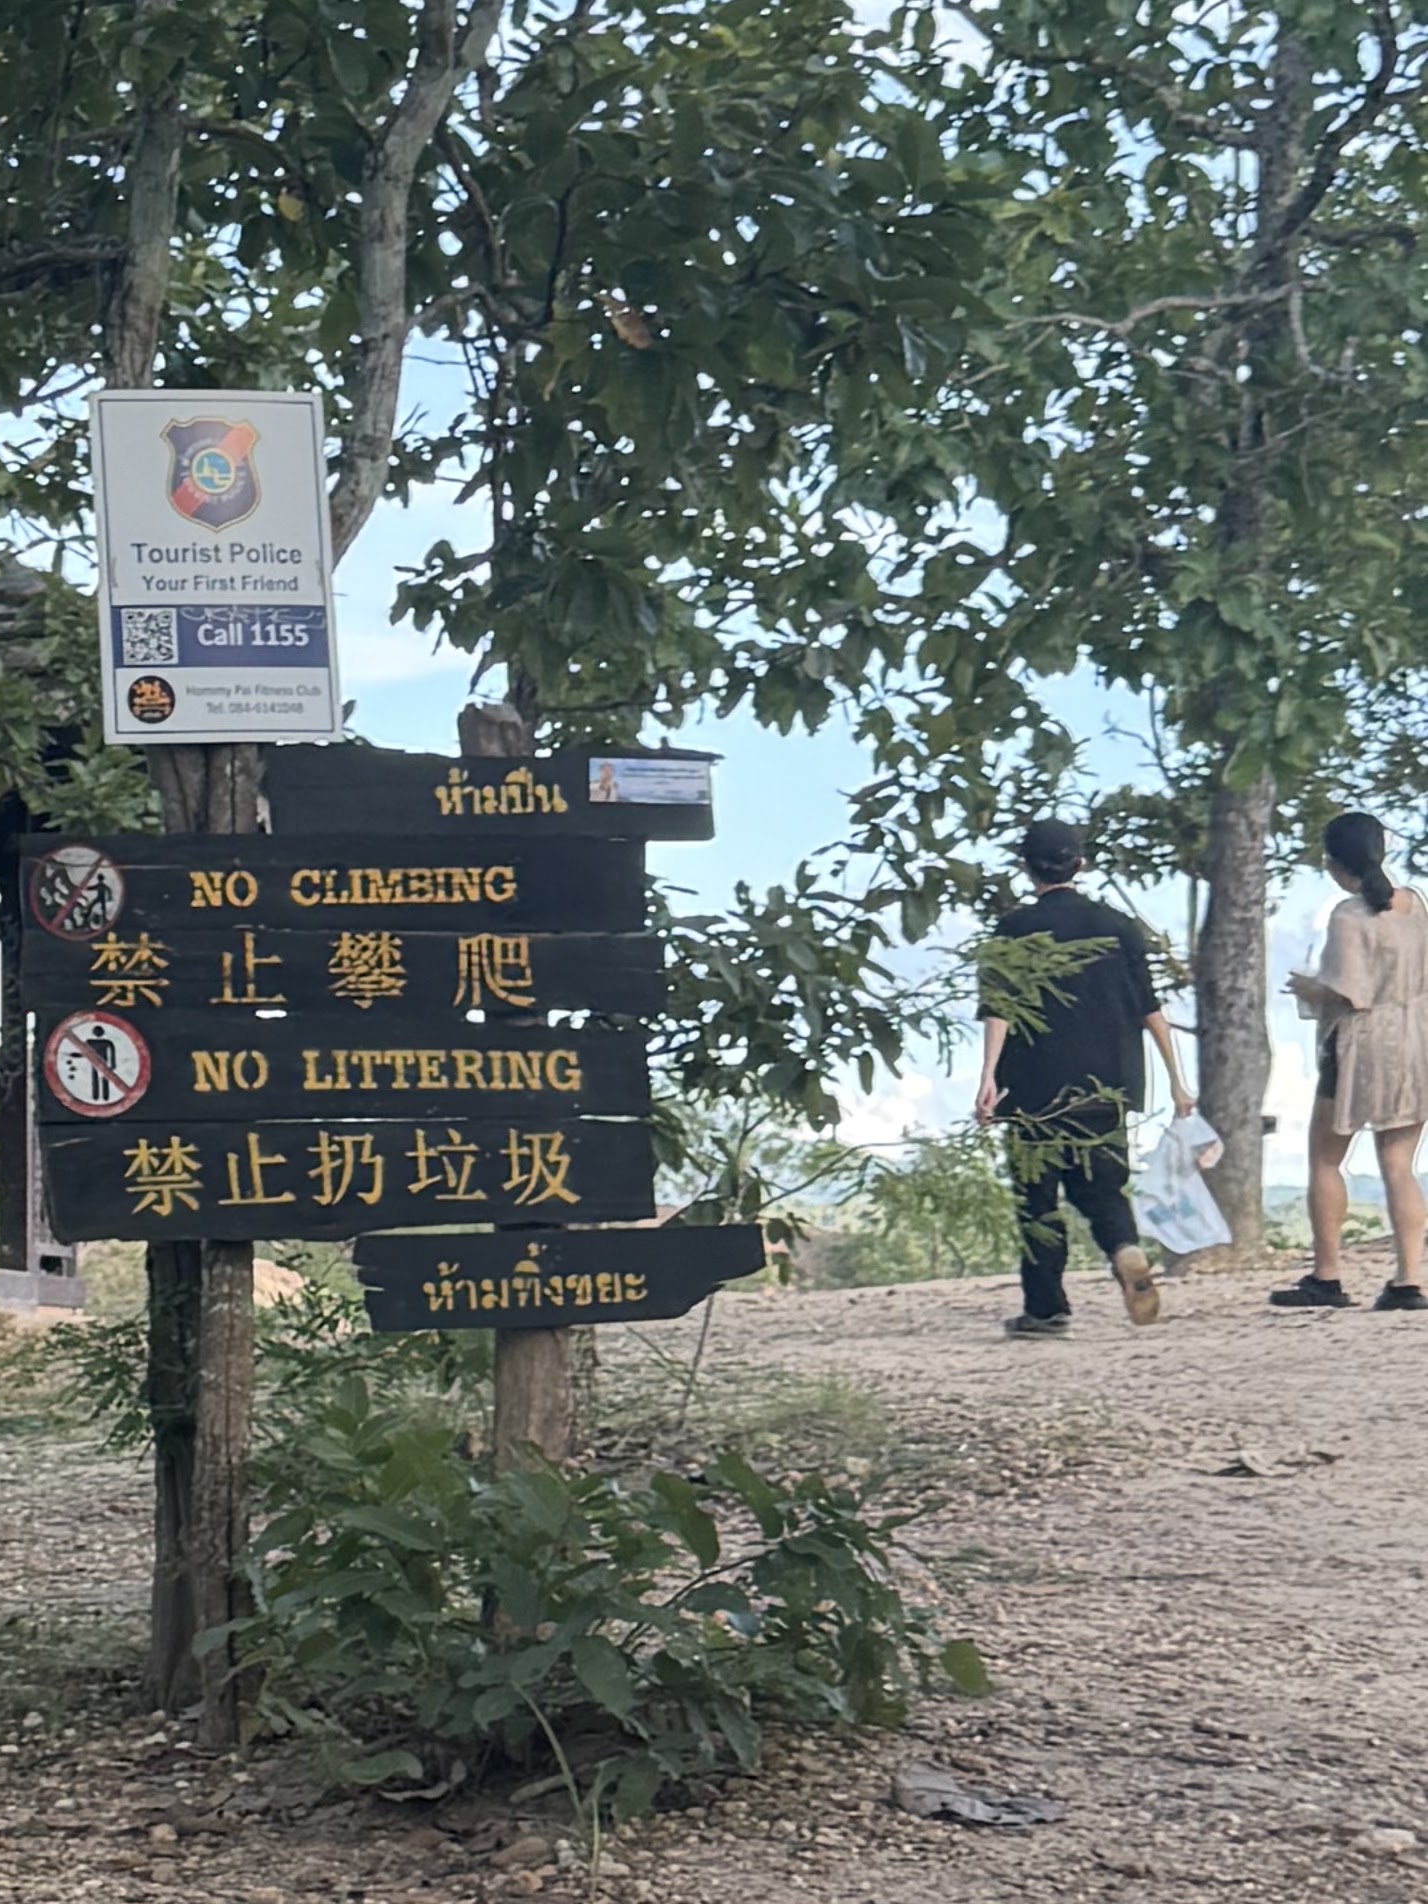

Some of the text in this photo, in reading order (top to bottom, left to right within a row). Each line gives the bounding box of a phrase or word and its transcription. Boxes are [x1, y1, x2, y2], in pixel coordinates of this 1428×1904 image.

[131, 543, 303, 566] Tourist Police
[142, 575, 299, 593] Your First Friend
[197, 623, 310, 647] Call 1155
[435, 766, 569, 815] ห้ามปีน
[189, 868, 515, 908] NO CLIMBING
[89, 931, 537, 1009] 禁止攀爬
[191, 1051, 580, 1093] NO LITTERING
[122, 1128, 582, 1218] 禁止扔垃圾
